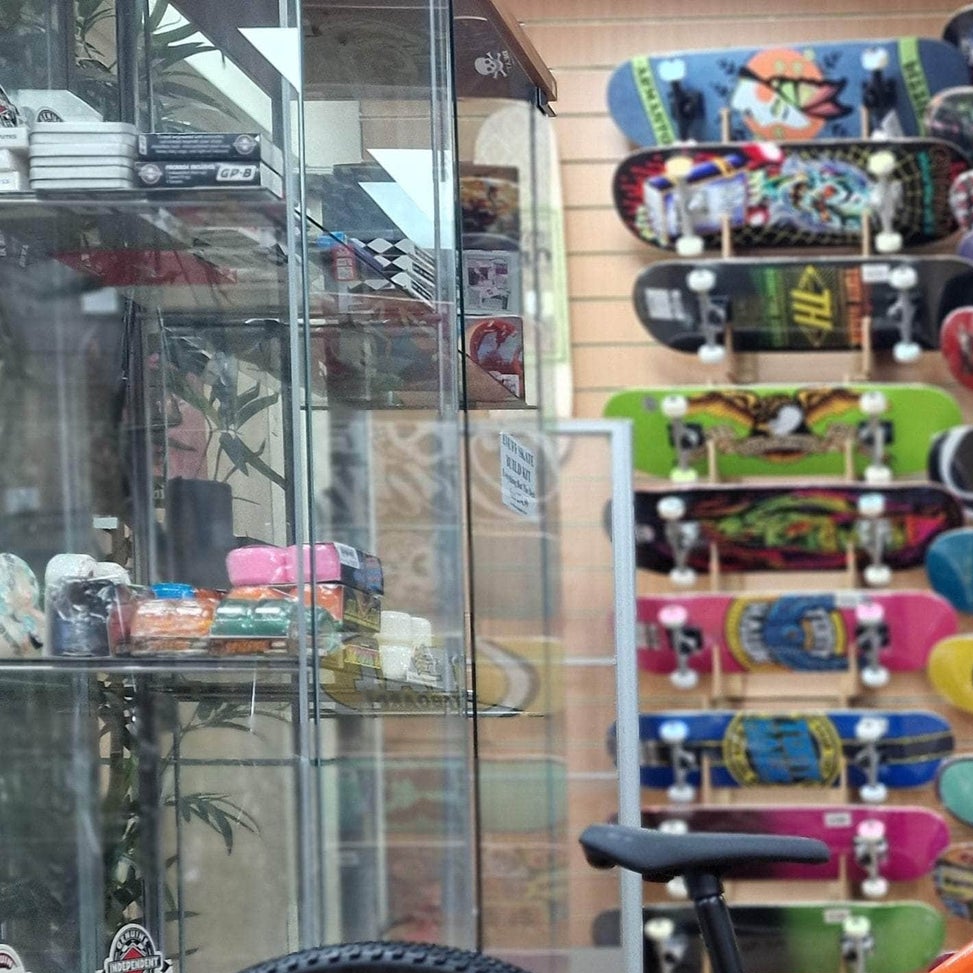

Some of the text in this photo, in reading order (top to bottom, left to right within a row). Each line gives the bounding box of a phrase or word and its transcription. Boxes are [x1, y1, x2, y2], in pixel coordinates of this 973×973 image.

[220, 168, 252, 178] GP-B
[116, 930, 149, 950] GENUINE
[110, 956, 160, 973] INDEPENDENT
